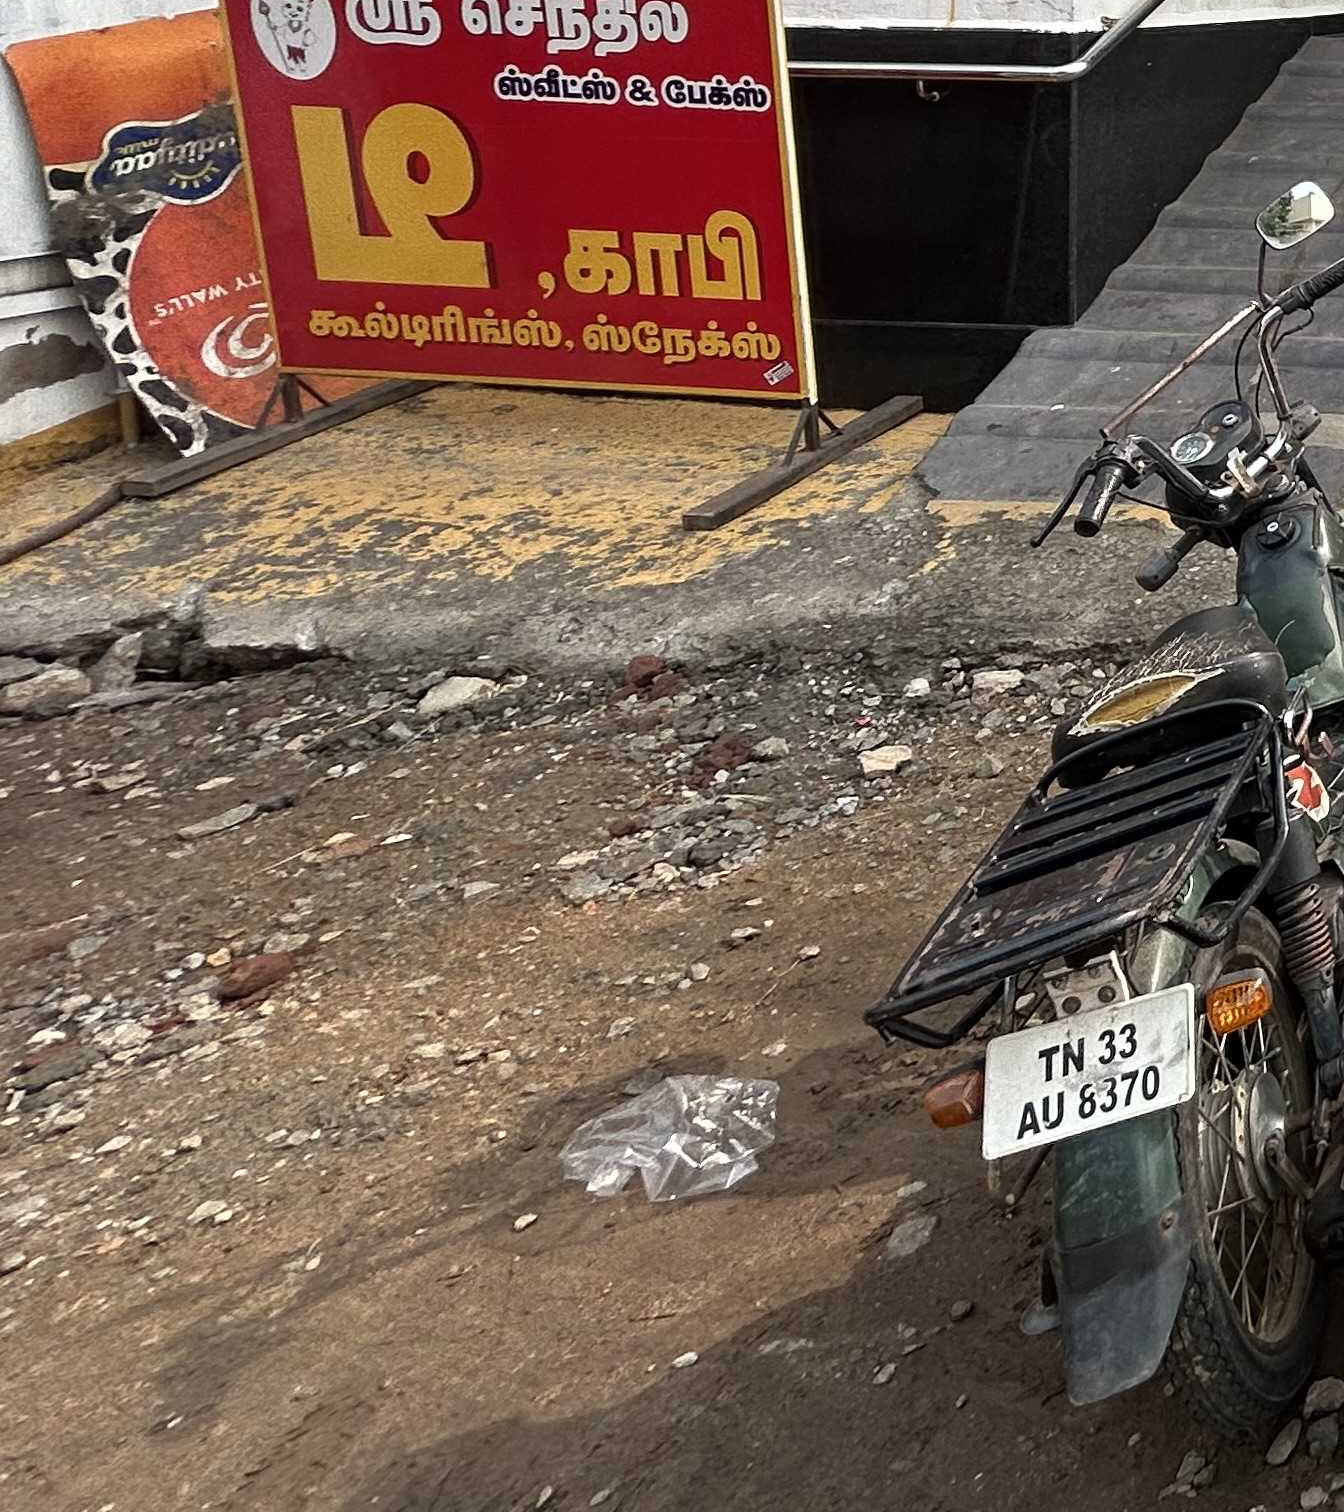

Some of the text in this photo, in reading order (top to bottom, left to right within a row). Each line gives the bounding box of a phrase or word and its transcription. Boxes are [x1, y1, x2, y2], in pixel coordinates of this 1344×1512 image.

[494, 64, 771, 112] ஸ்வீட்ஸ் & பேக்ஸ்
[291, 102, 492, 289] டி
[582, 312, 782, 364] ஸ்நேக்ஸ்
[1037, 1022, 1138, 1083] TN 33
[1015, 1064, 1162, 1141] AU 8370
